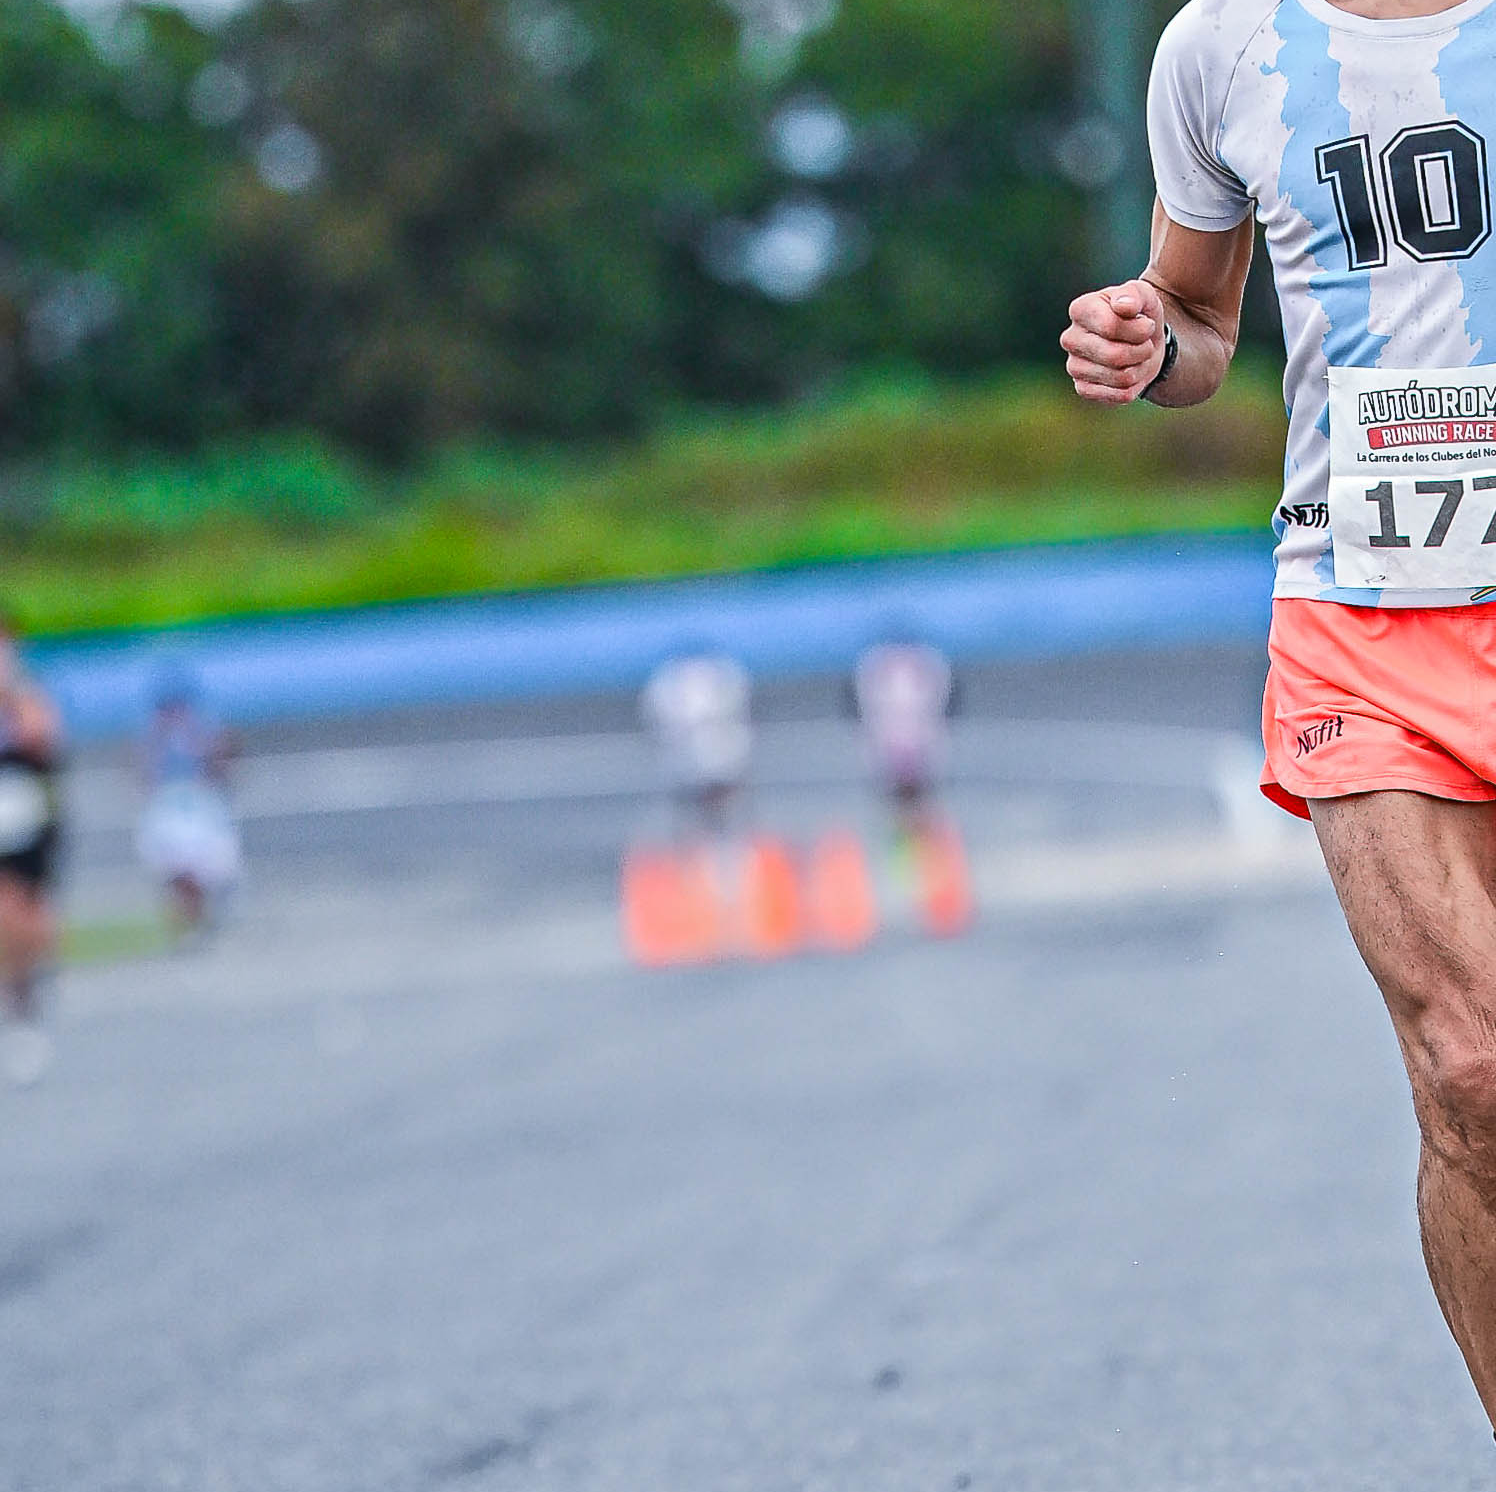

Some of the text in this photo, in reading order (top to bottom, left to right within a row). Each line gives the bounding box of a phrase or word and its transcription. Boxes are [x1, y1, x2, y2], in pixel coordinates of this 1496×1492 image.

[1313, 119, 1493, 272] 10
[1381, 423, 1495, 447] RUNNING RACE
[1357, 452, 1367, 462] La
[1368, 452, 1400, 463] Carrera
[1402, 452, 1414, 462] de
[1416, 451, 1429, 462] los
[1431, 450, 1464, 461] Clubes
[1466, 448, 1481, 459] del
